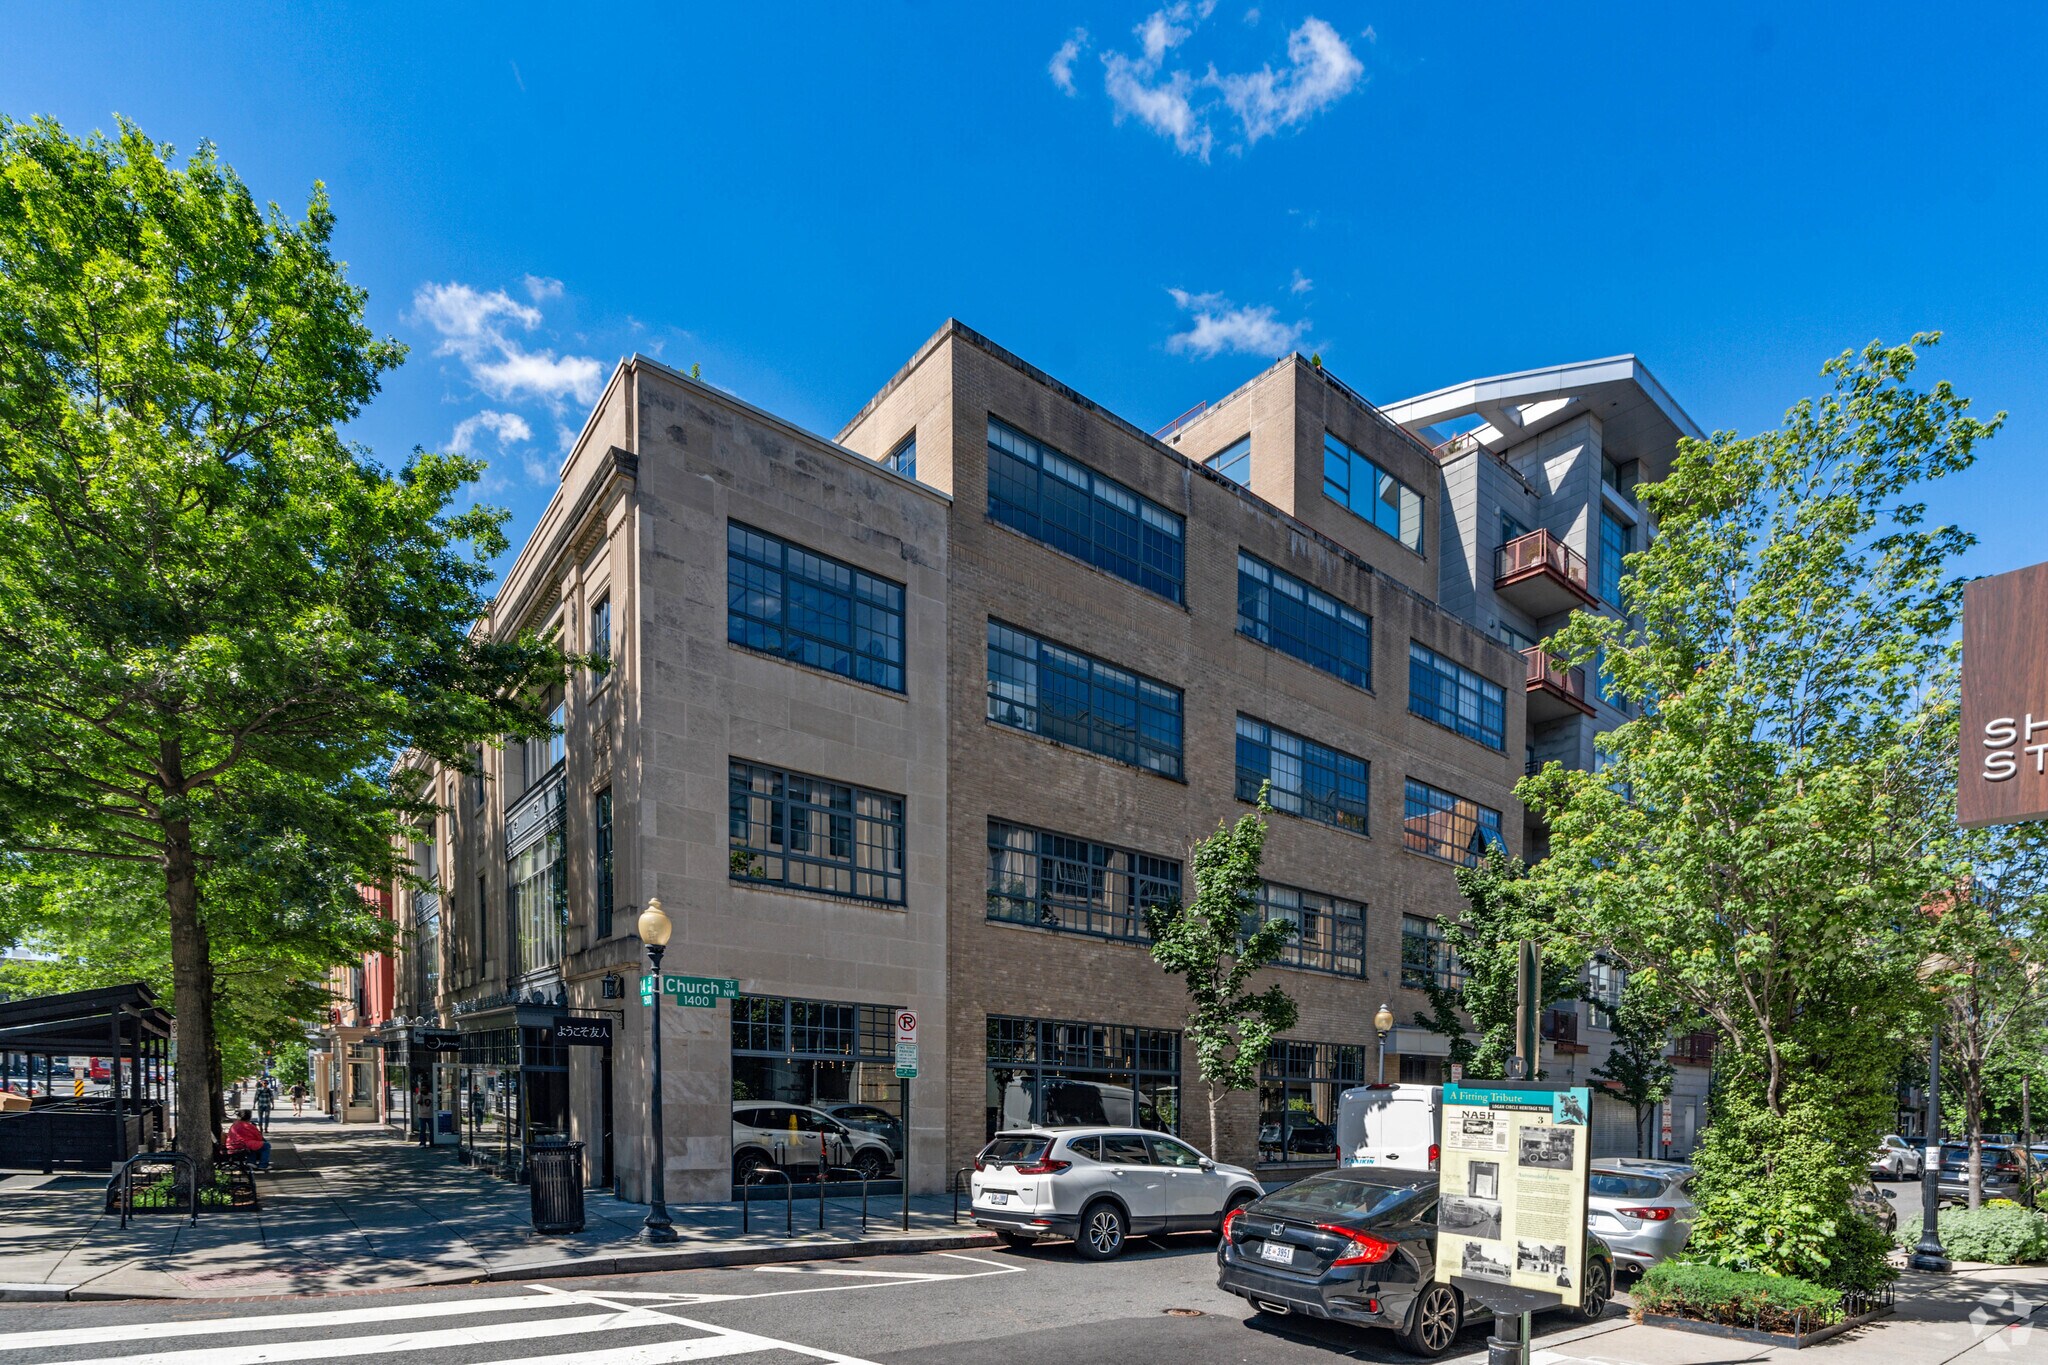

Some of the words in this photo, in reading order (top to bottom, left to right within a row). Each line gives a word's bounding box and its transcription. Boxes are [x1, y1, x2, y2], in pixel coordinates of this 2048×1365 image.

[666, 978, 719, 994] Church
[723, 989, 735, 997] NW
[684, 996, 709, 1006] 1400
[557, 1025, 610, 1038] ようこそ友人
[1450, 1091, 1457, 1100] A
[1460, 1091, 1488, 1103] Fitting
[1490, 1092, 1522, 1102] Tribute
[1462, 1111, 1495, 1119] NASH
[1538, 1116, 1543, 1124] 3
